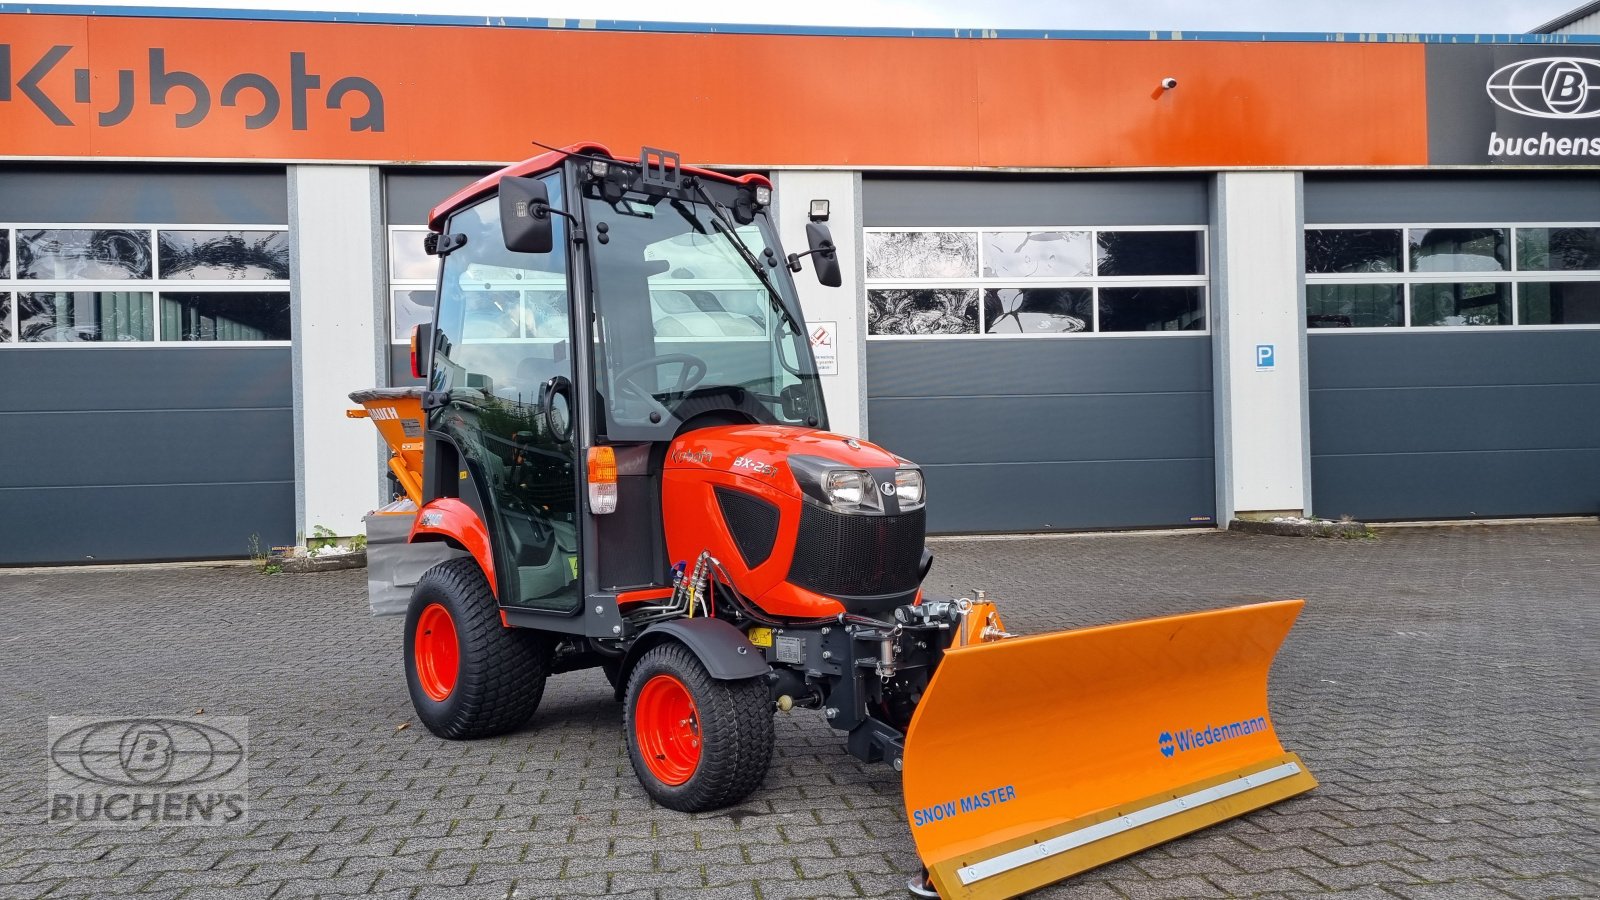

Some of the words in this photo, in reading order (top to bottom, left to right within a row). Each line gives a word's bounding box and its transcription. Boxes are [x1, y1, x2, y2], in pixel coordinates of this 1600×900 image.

[0, 44, 385, 132] Kubota
[1258, 347, 1272, 365] P
[1174, 716, 1267, 752] Wiedenmann
[913, 799, 956, 827] SNOW
[960, 785, 1016, 813] MASTER
